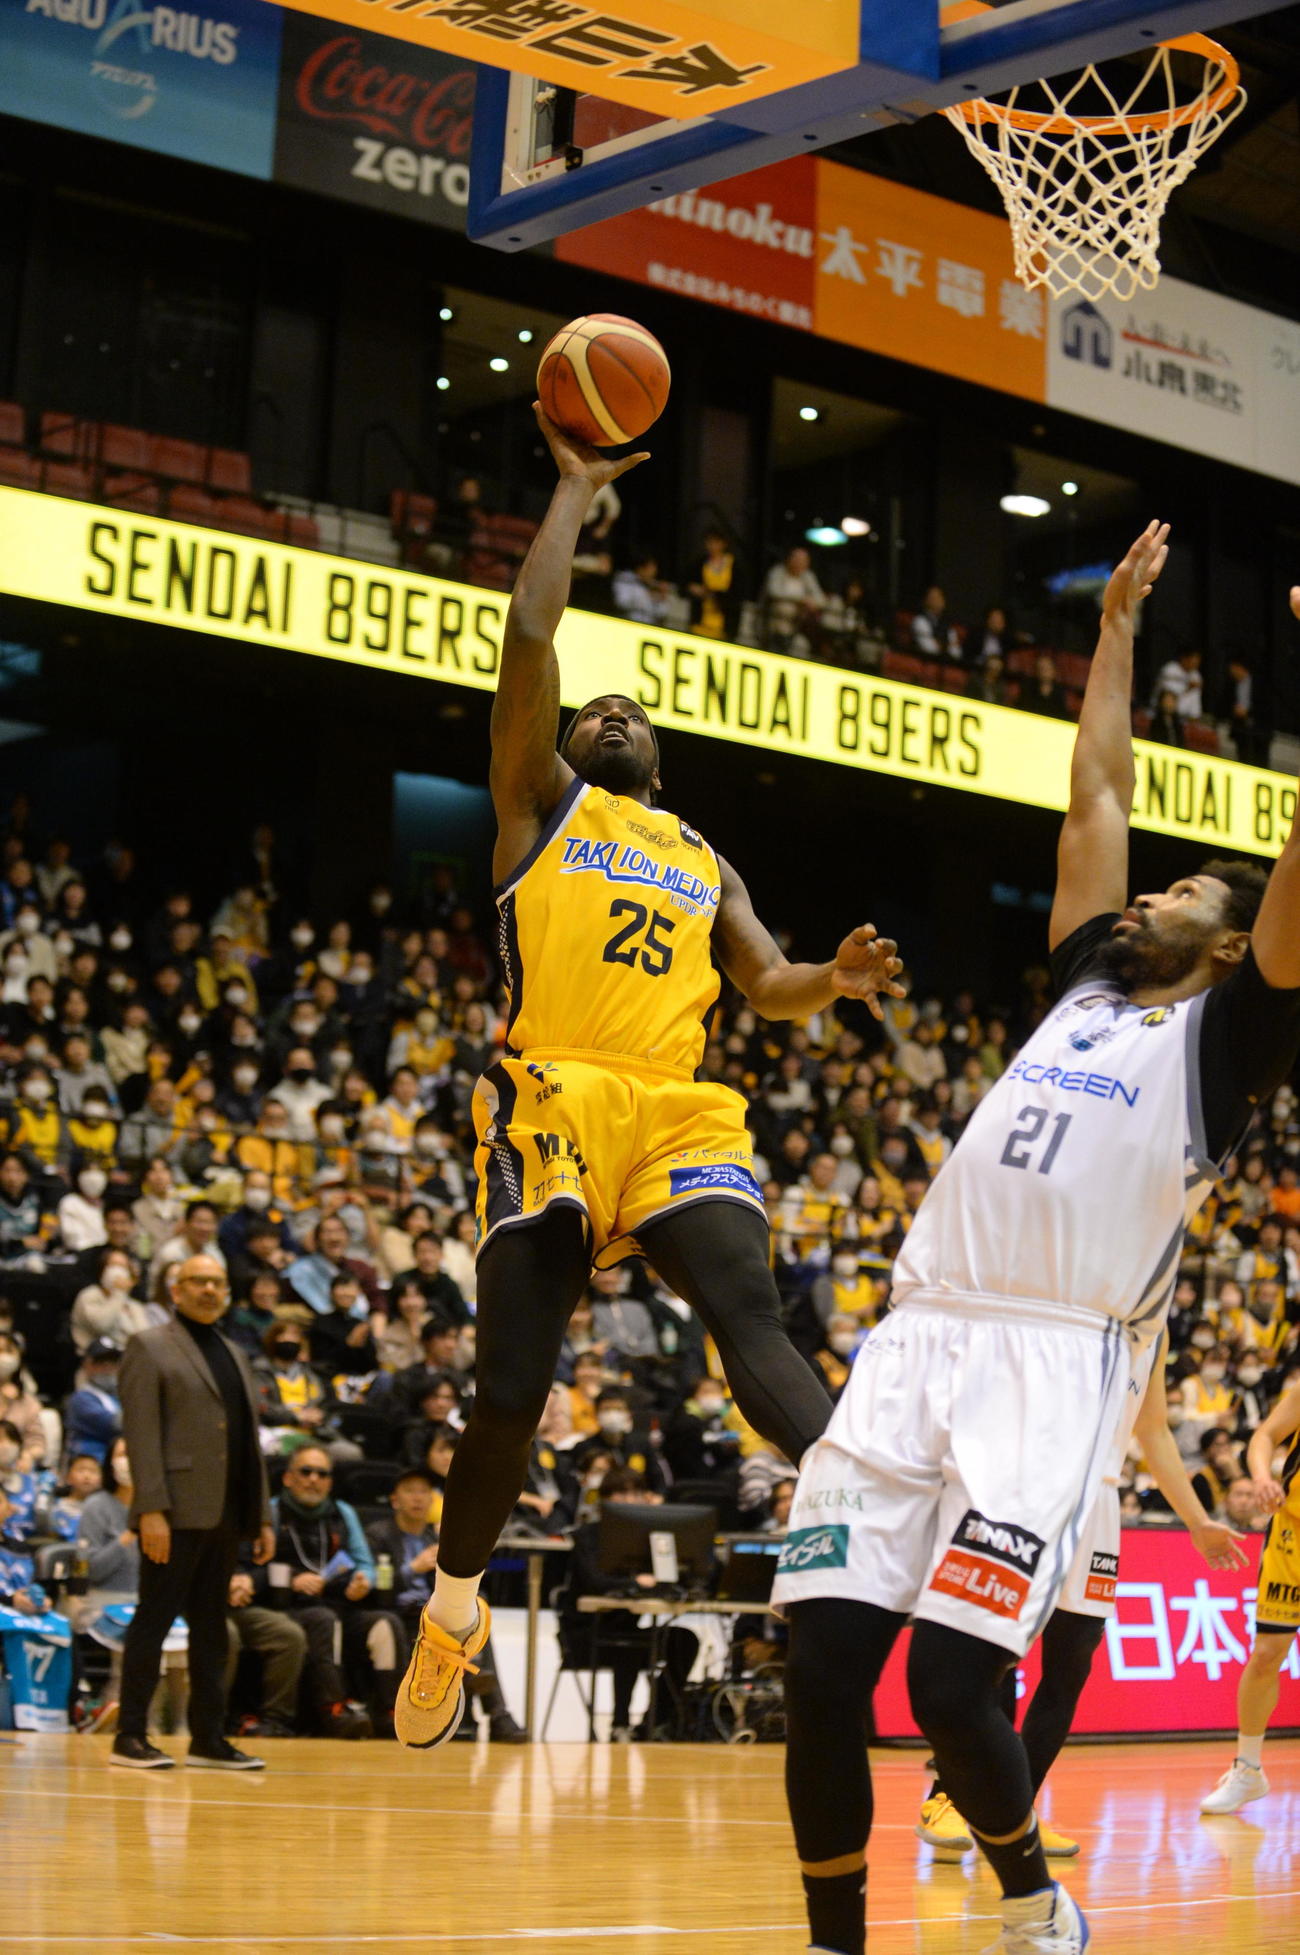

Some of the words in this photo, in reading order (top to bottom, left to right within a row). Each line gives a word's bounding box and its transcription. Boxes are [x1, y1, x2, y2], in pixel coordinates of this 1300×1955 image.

[378, 0, 770, 96] 本山製
[351, 136, 469, 207] zero
[84, 520, 294, 634] SENDAI
[325, 571, 502, 675] 89ERS
[637, 640, 810, 743] SENDAI
[837, 685, 982, 778] 89ERS
[1131, 752, 1233, 843] NDAI
[603, 898, 677, 977] 25
[999, 1104, 1072, 1175] 21
[964, 1566, 1020, 1610] Live
[1105, 1578, 1258, 1682] 日本
